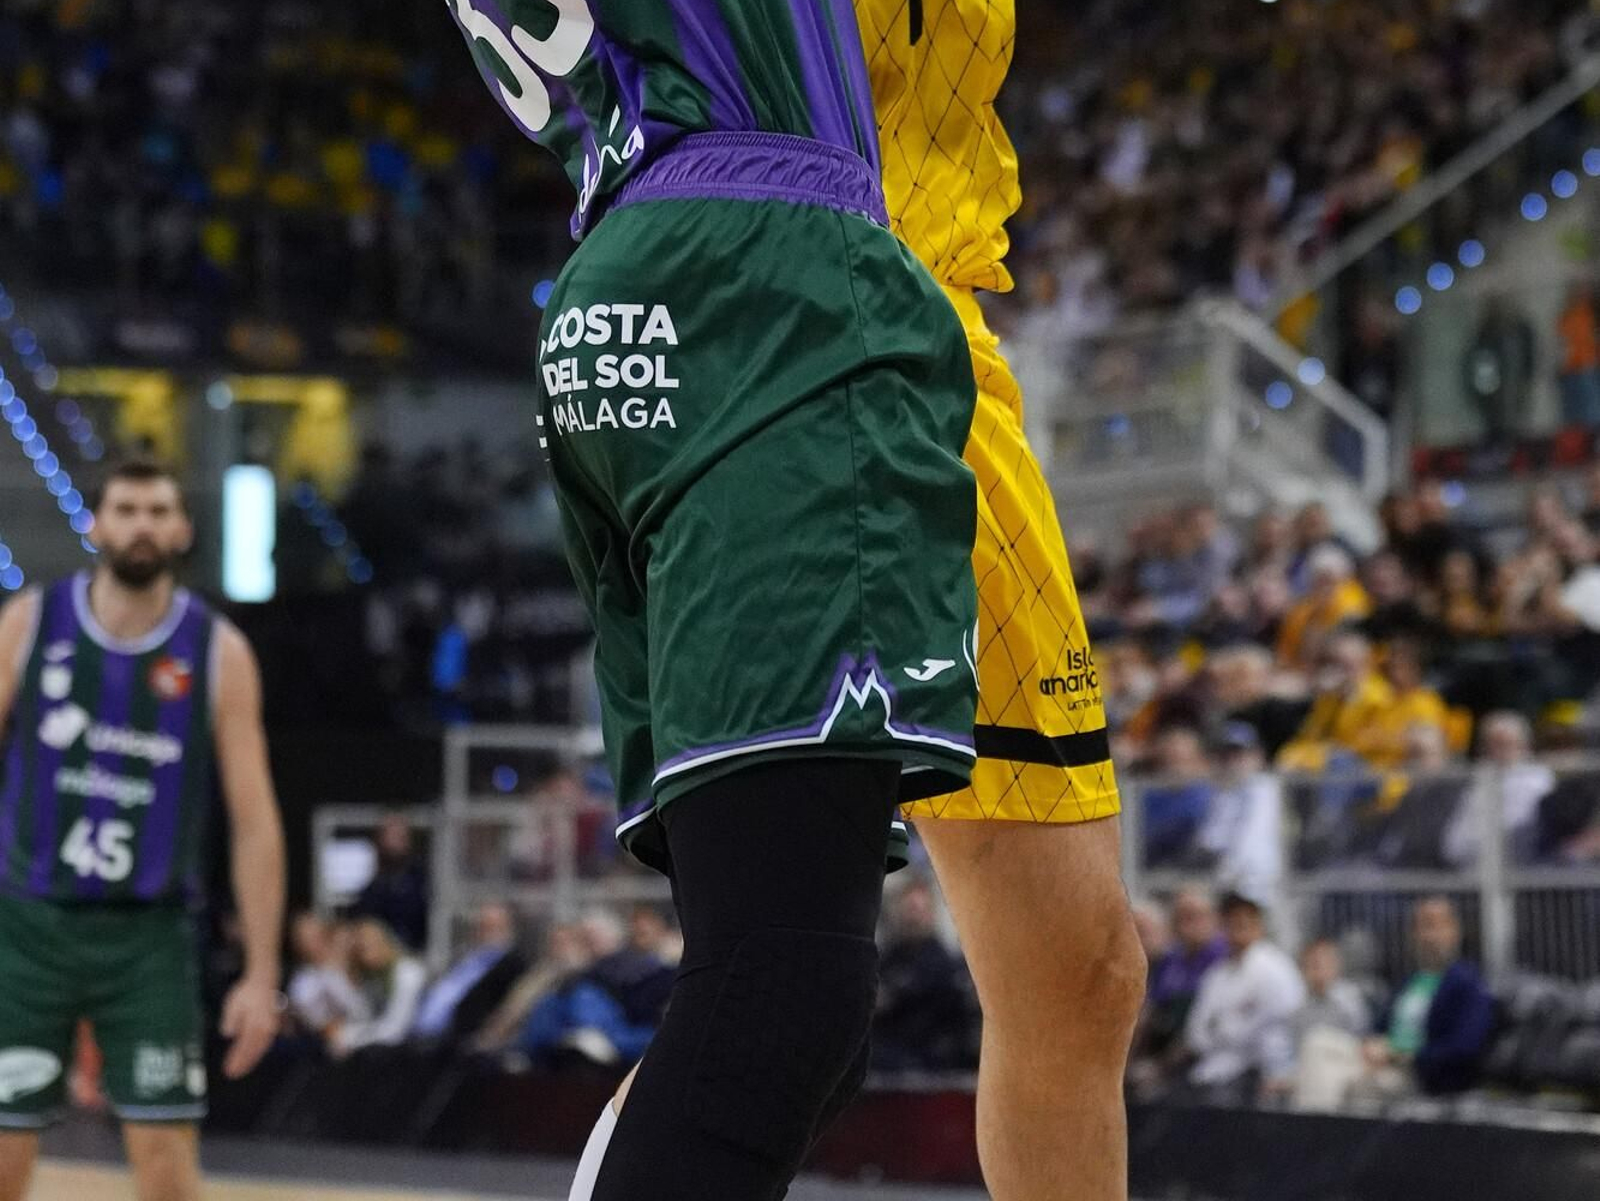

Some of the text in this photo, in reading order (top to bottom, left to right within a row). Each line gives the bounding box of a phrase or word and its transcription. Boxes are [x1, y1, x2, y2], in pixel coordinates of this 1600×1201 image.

[547, 304, 679, 352] COSTA
[542, 354, 679, 398] DEL SOL
[553, 393, 677, 436] MÁLAGA
[60, 815, 135, 882] 45
